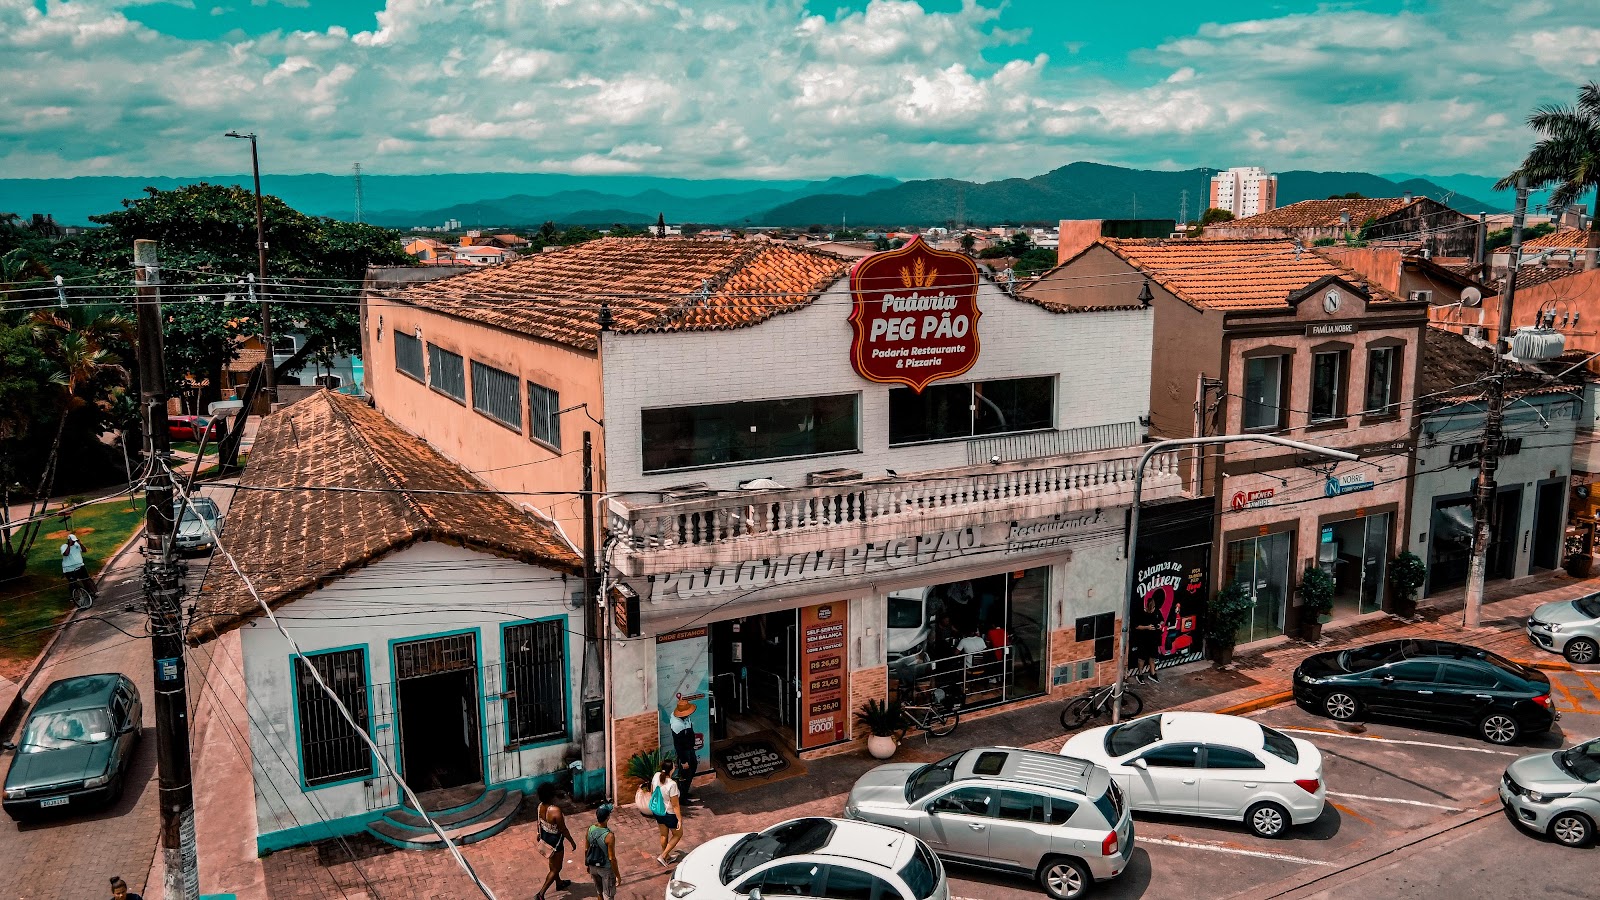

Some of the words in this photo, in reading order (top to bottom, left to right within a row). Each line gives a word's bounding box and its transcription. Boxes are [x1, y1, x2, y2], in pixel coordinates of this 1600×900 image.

[882, 291, 957, 313] Padaria
[1328, 296, 1337, 310] N
[870, 317, 917, 342] PEG
[921, 312, 969, 339] PÃO
[1313, 324, 1334, 334] FAMÍLIA
[1335, 324, 1353, 333] NOBRE
[872, 347, 909, 358] Padaria
[911, 345, 966, 356] Restaurante
[896, 359, 903, 368] &
[905, 357, 942, 368] Pizzaria
[1342, 474, 1363, 484] NOBRE
[1250, 490, 1273, 500] IMÓVEIS
[1009, 517, 1093, 539] Restaurante
[843, 538, 918, 576] PEG
[1138, 561, 1171, 582] Estamos
[1171, 562, 1182, 572] no
[1137, 574, 1181, 598] Delivery
[658, 633, 676, 642] ONDE
[677, 629, 705, 640] ESTAMOS
[806, 624, 843, 636] SELF-SERVICE
[818, 631, 842, 641] BALANÇA
[810, 662, 820, 670] R$
[811, 681, 821, 689] R$
[821, 678, 839, 688] 21,49
[812, 705, 822, 713] R$
[822, 701, 839, 711] 26,10
[726, 749, 767, 761] Padaria
[727, 759, 751, 771] PEG
[752, 752, 778, 765] PÃO
[731, 767, 753, 776] Padaria
[752, 760, 784, 770] Restaurante
[753, 766, 774, 775] Pizzaria
